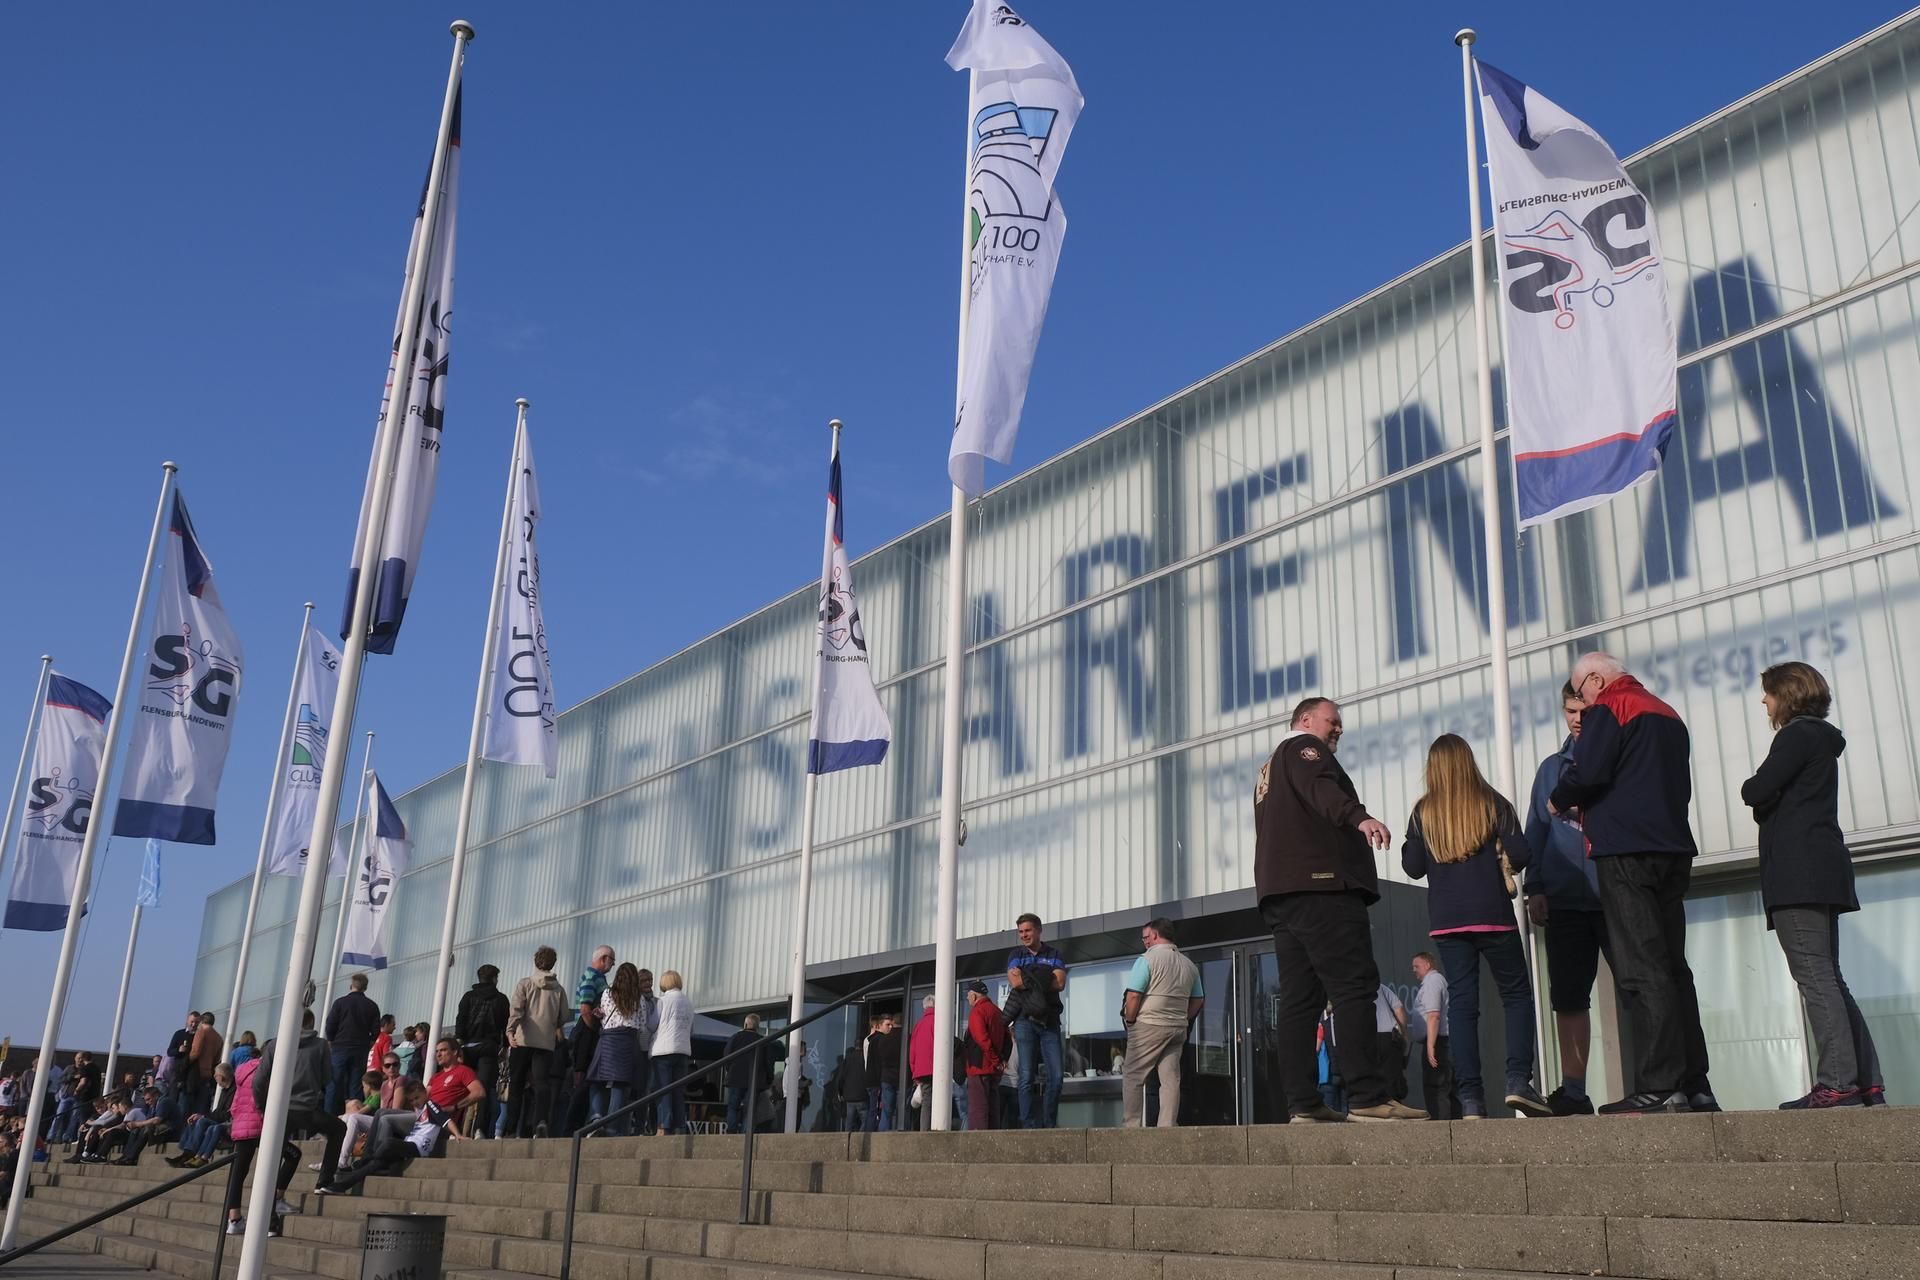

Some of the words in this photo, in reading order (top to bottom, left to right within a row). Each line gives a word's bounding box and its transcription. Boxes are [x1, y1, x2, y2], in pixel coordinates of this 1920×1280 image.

[992, 225, 1041, 252] 100
[986, 254, 1014, 263] CHAFT
[1017, 257, 1035, 268] E.V.
[937, 256, 1900, 800] ARENA
[321, 650, 338, 671] SG
[149, 634, 235, 718] SG
[290, 769, 322, 785] CLUB
[28, 777, 94, 834] SG
